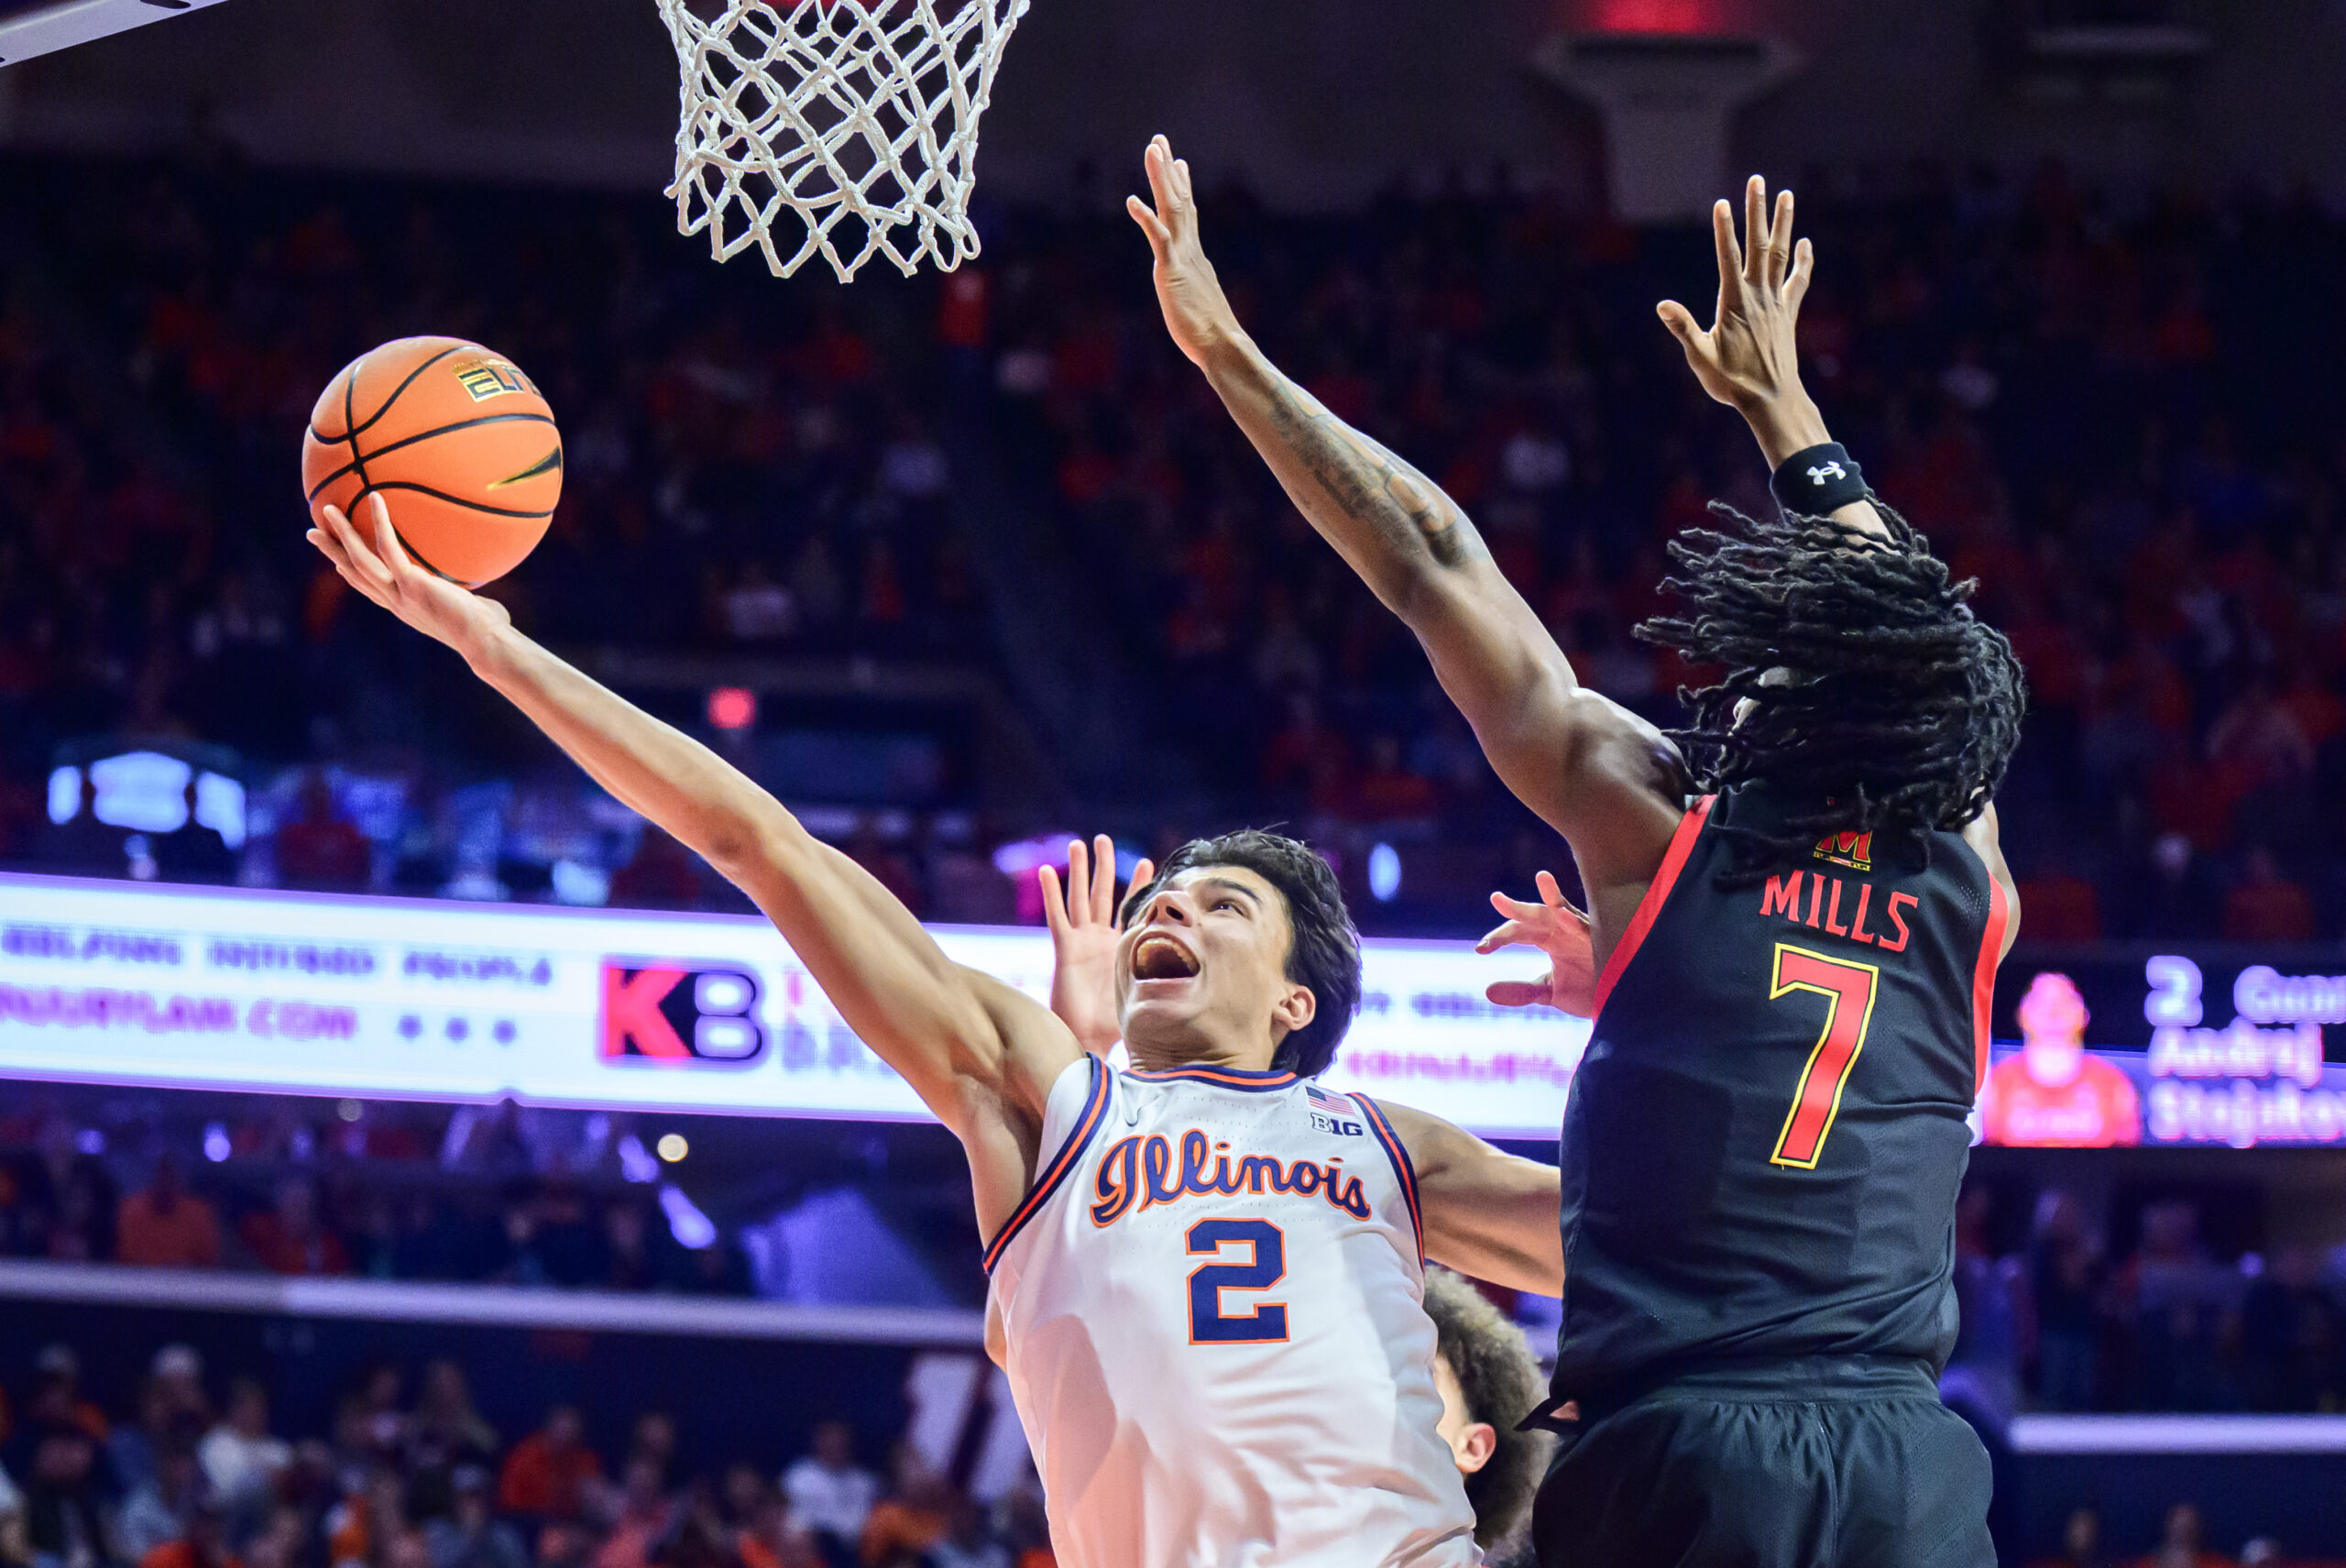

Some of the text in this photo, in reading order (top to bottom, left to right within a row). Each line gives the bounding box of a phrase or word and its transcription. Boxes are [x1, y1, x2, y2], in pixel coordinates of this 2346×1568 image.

[1760, 870, 1918, 951] MILLS
[2145, 955, 2203, 1026] 2
[1769, 943, 1879, 1169] 7
[1090, 1128, 1372, 1228] Illinois
[1185, 1217, 1290, 1345] 2
